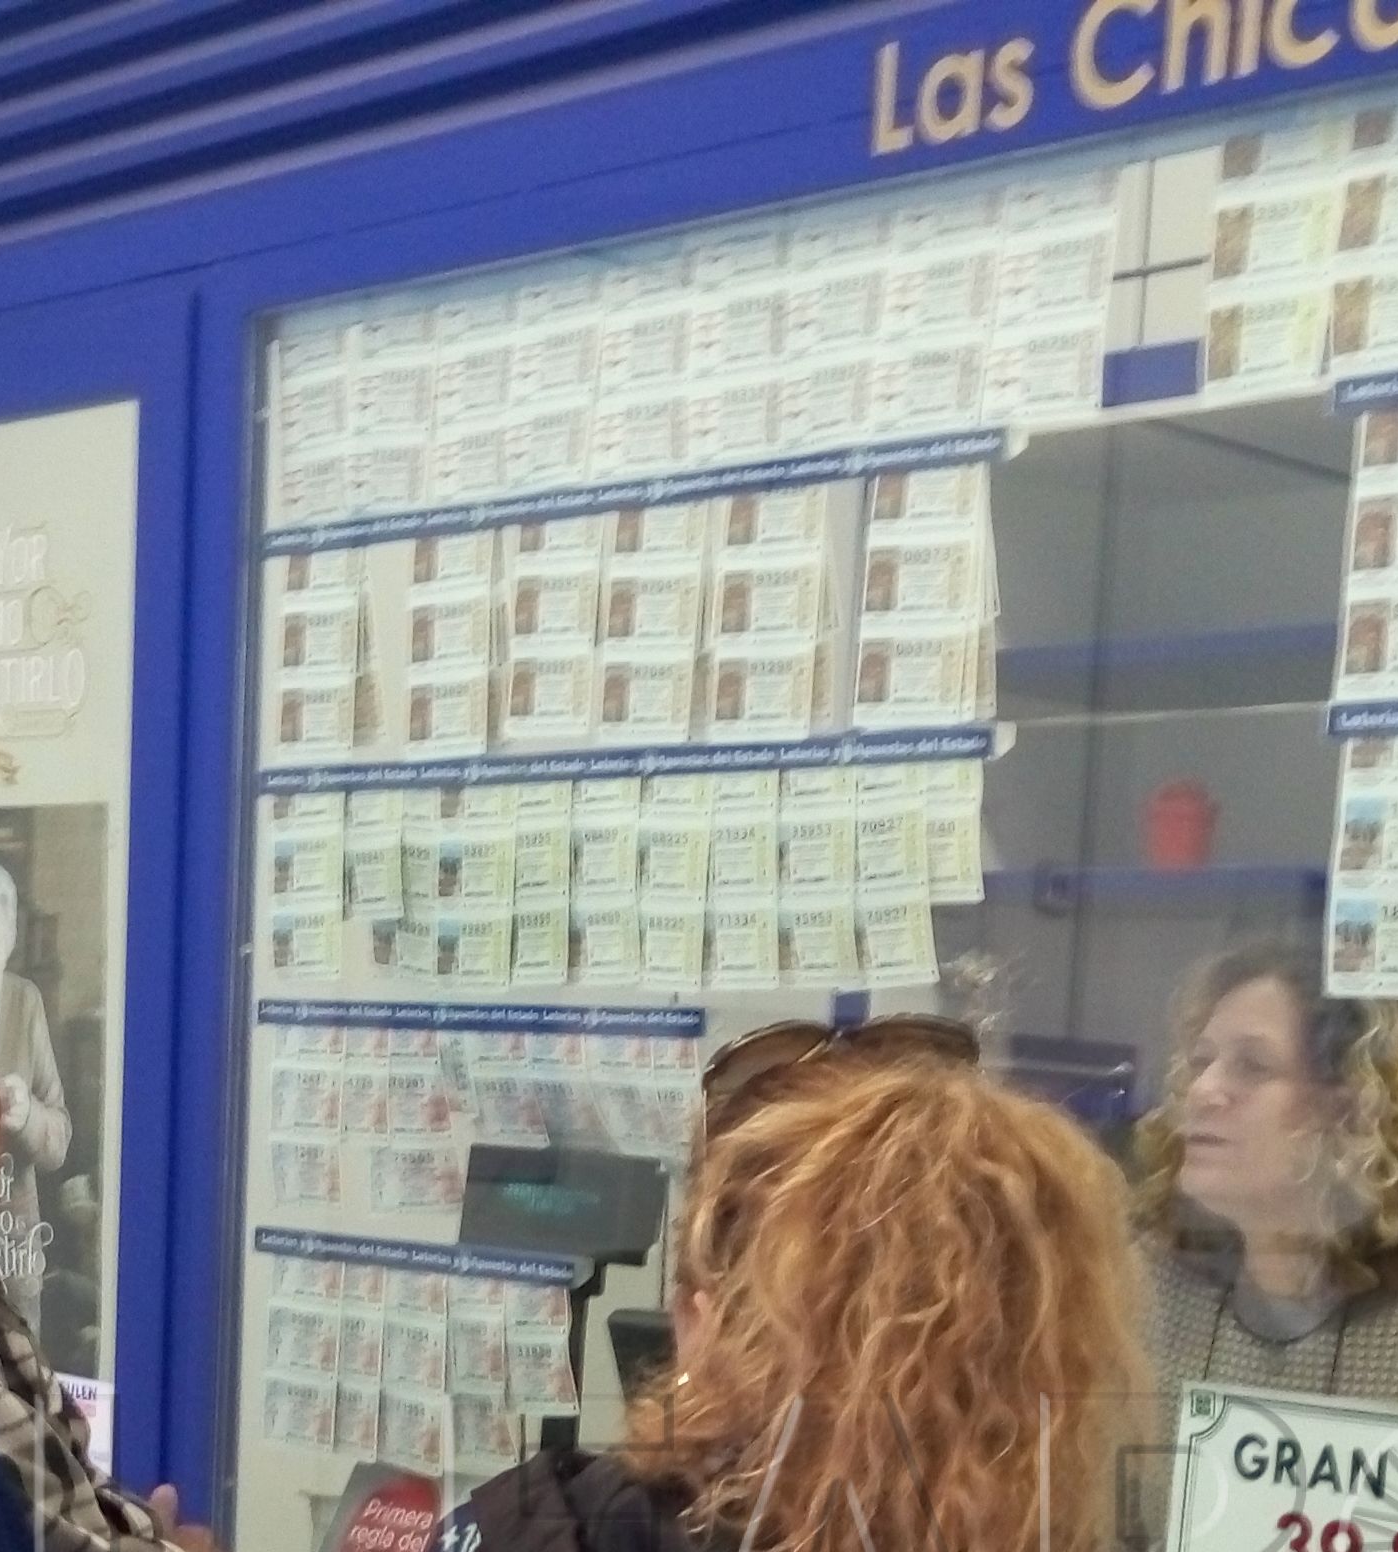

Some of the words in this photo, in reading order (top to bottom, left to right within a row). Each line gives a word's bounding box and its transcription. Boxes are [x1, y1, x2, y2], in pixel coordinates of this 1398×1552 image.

[871, 36, 1035, 158] Las
[1234, 1433, 1388, 1500] GRAN
[364, 1498, 434, 1531] Primera
